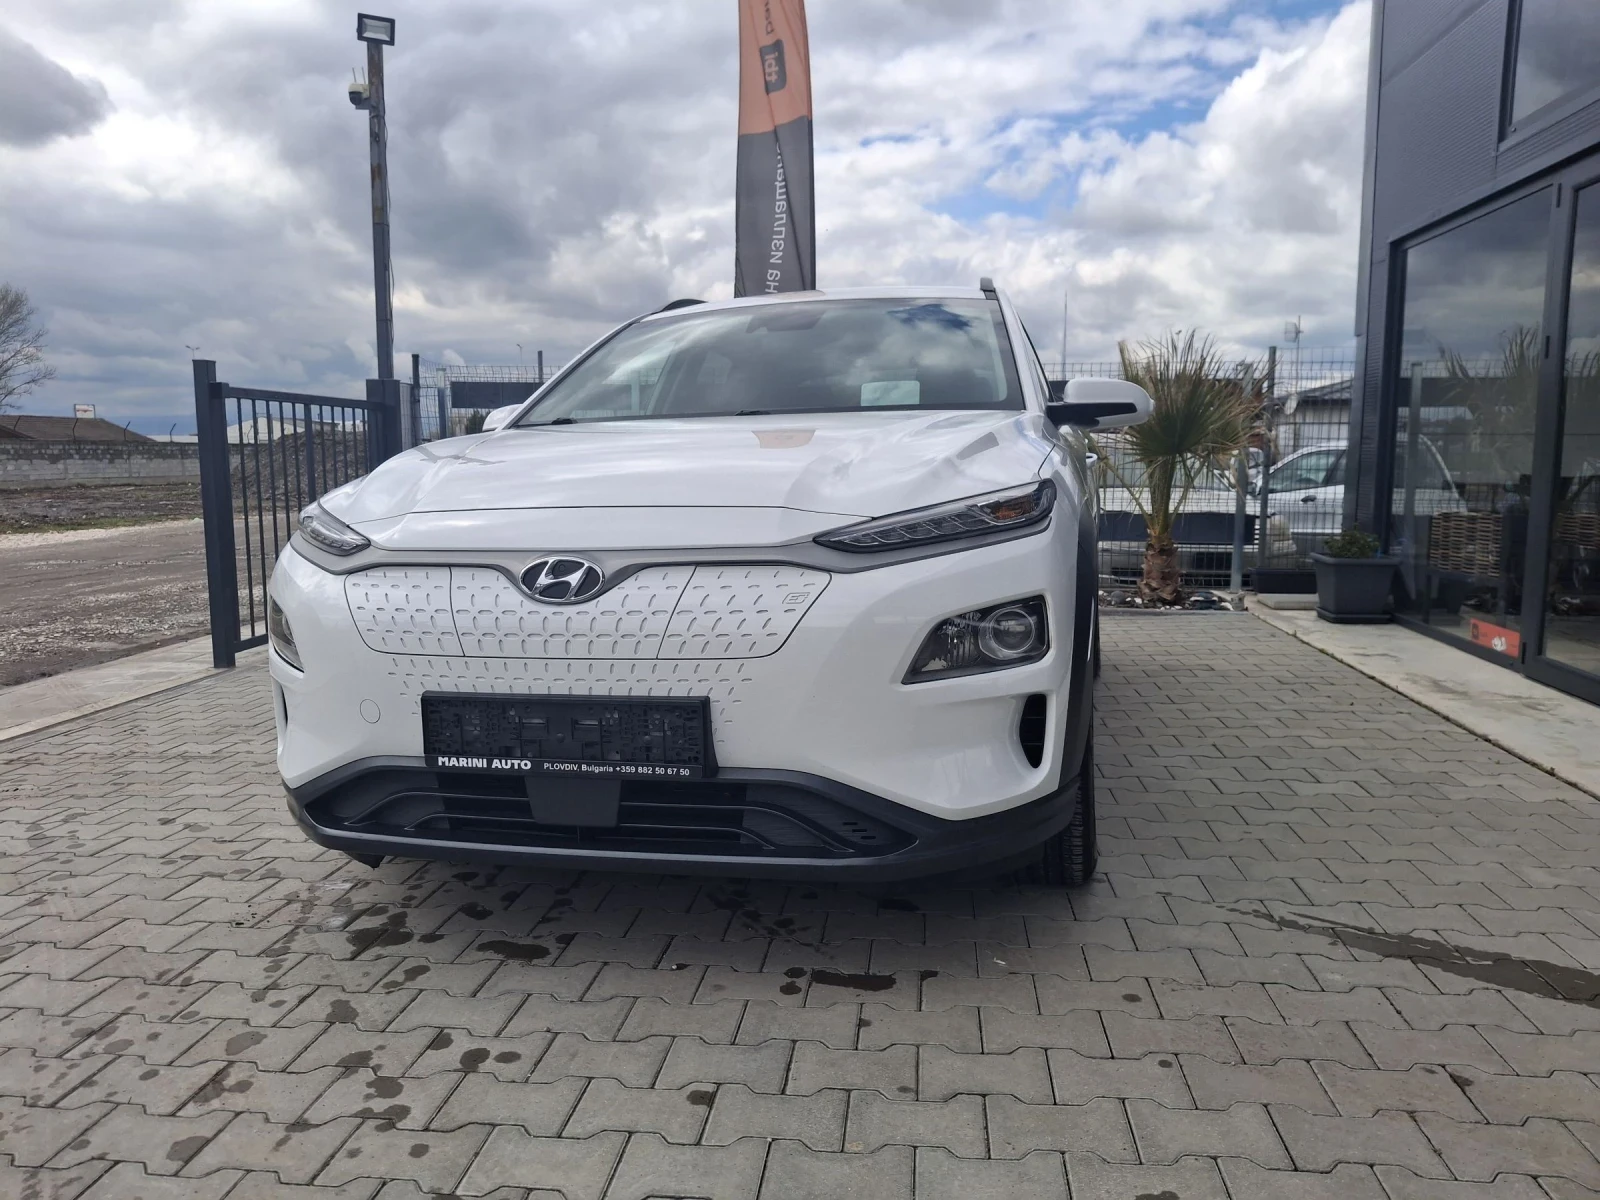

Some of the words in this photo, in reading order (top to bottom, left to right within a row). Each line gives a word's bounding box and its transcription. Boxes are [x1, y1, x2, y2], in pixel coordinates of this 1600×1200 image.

[437, 756, 487, 768] MARINI
[491, 758, 532, 770] AUTO
[543, 762, 580, 772] PLOVDIV,
[581, 764, 613, 773] Bulgaria
[615, 765, 636, 773] +359
[637, 766, 653, 774] 882
[655, 767, 665, 775] 50
[667, 767, 677, 775] 67
[679, 768, 690, 776] 50
